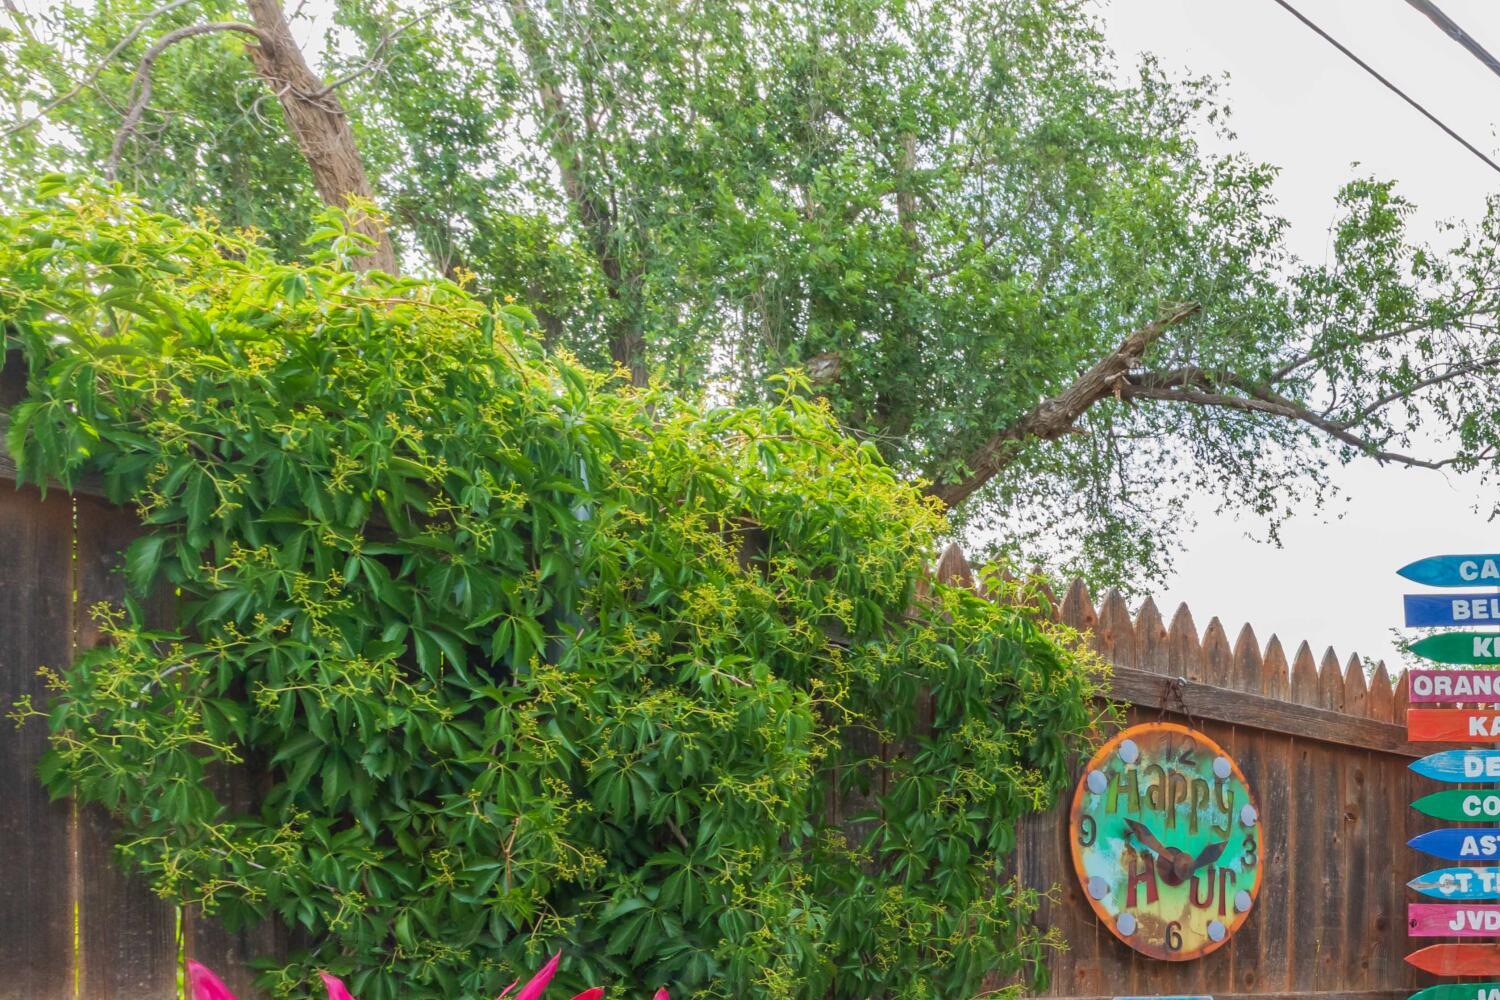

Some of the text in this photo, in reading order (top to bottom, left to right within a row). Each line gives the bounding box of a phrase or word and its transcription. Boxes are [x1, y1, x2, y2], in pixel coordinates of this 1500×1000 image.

[1104, 763, 1235, 839] Happy
[1078, 814, 1097, 848] 9
[1241, 834, 1258, 869] 3
[1165, 920, 1183, 951] 6
